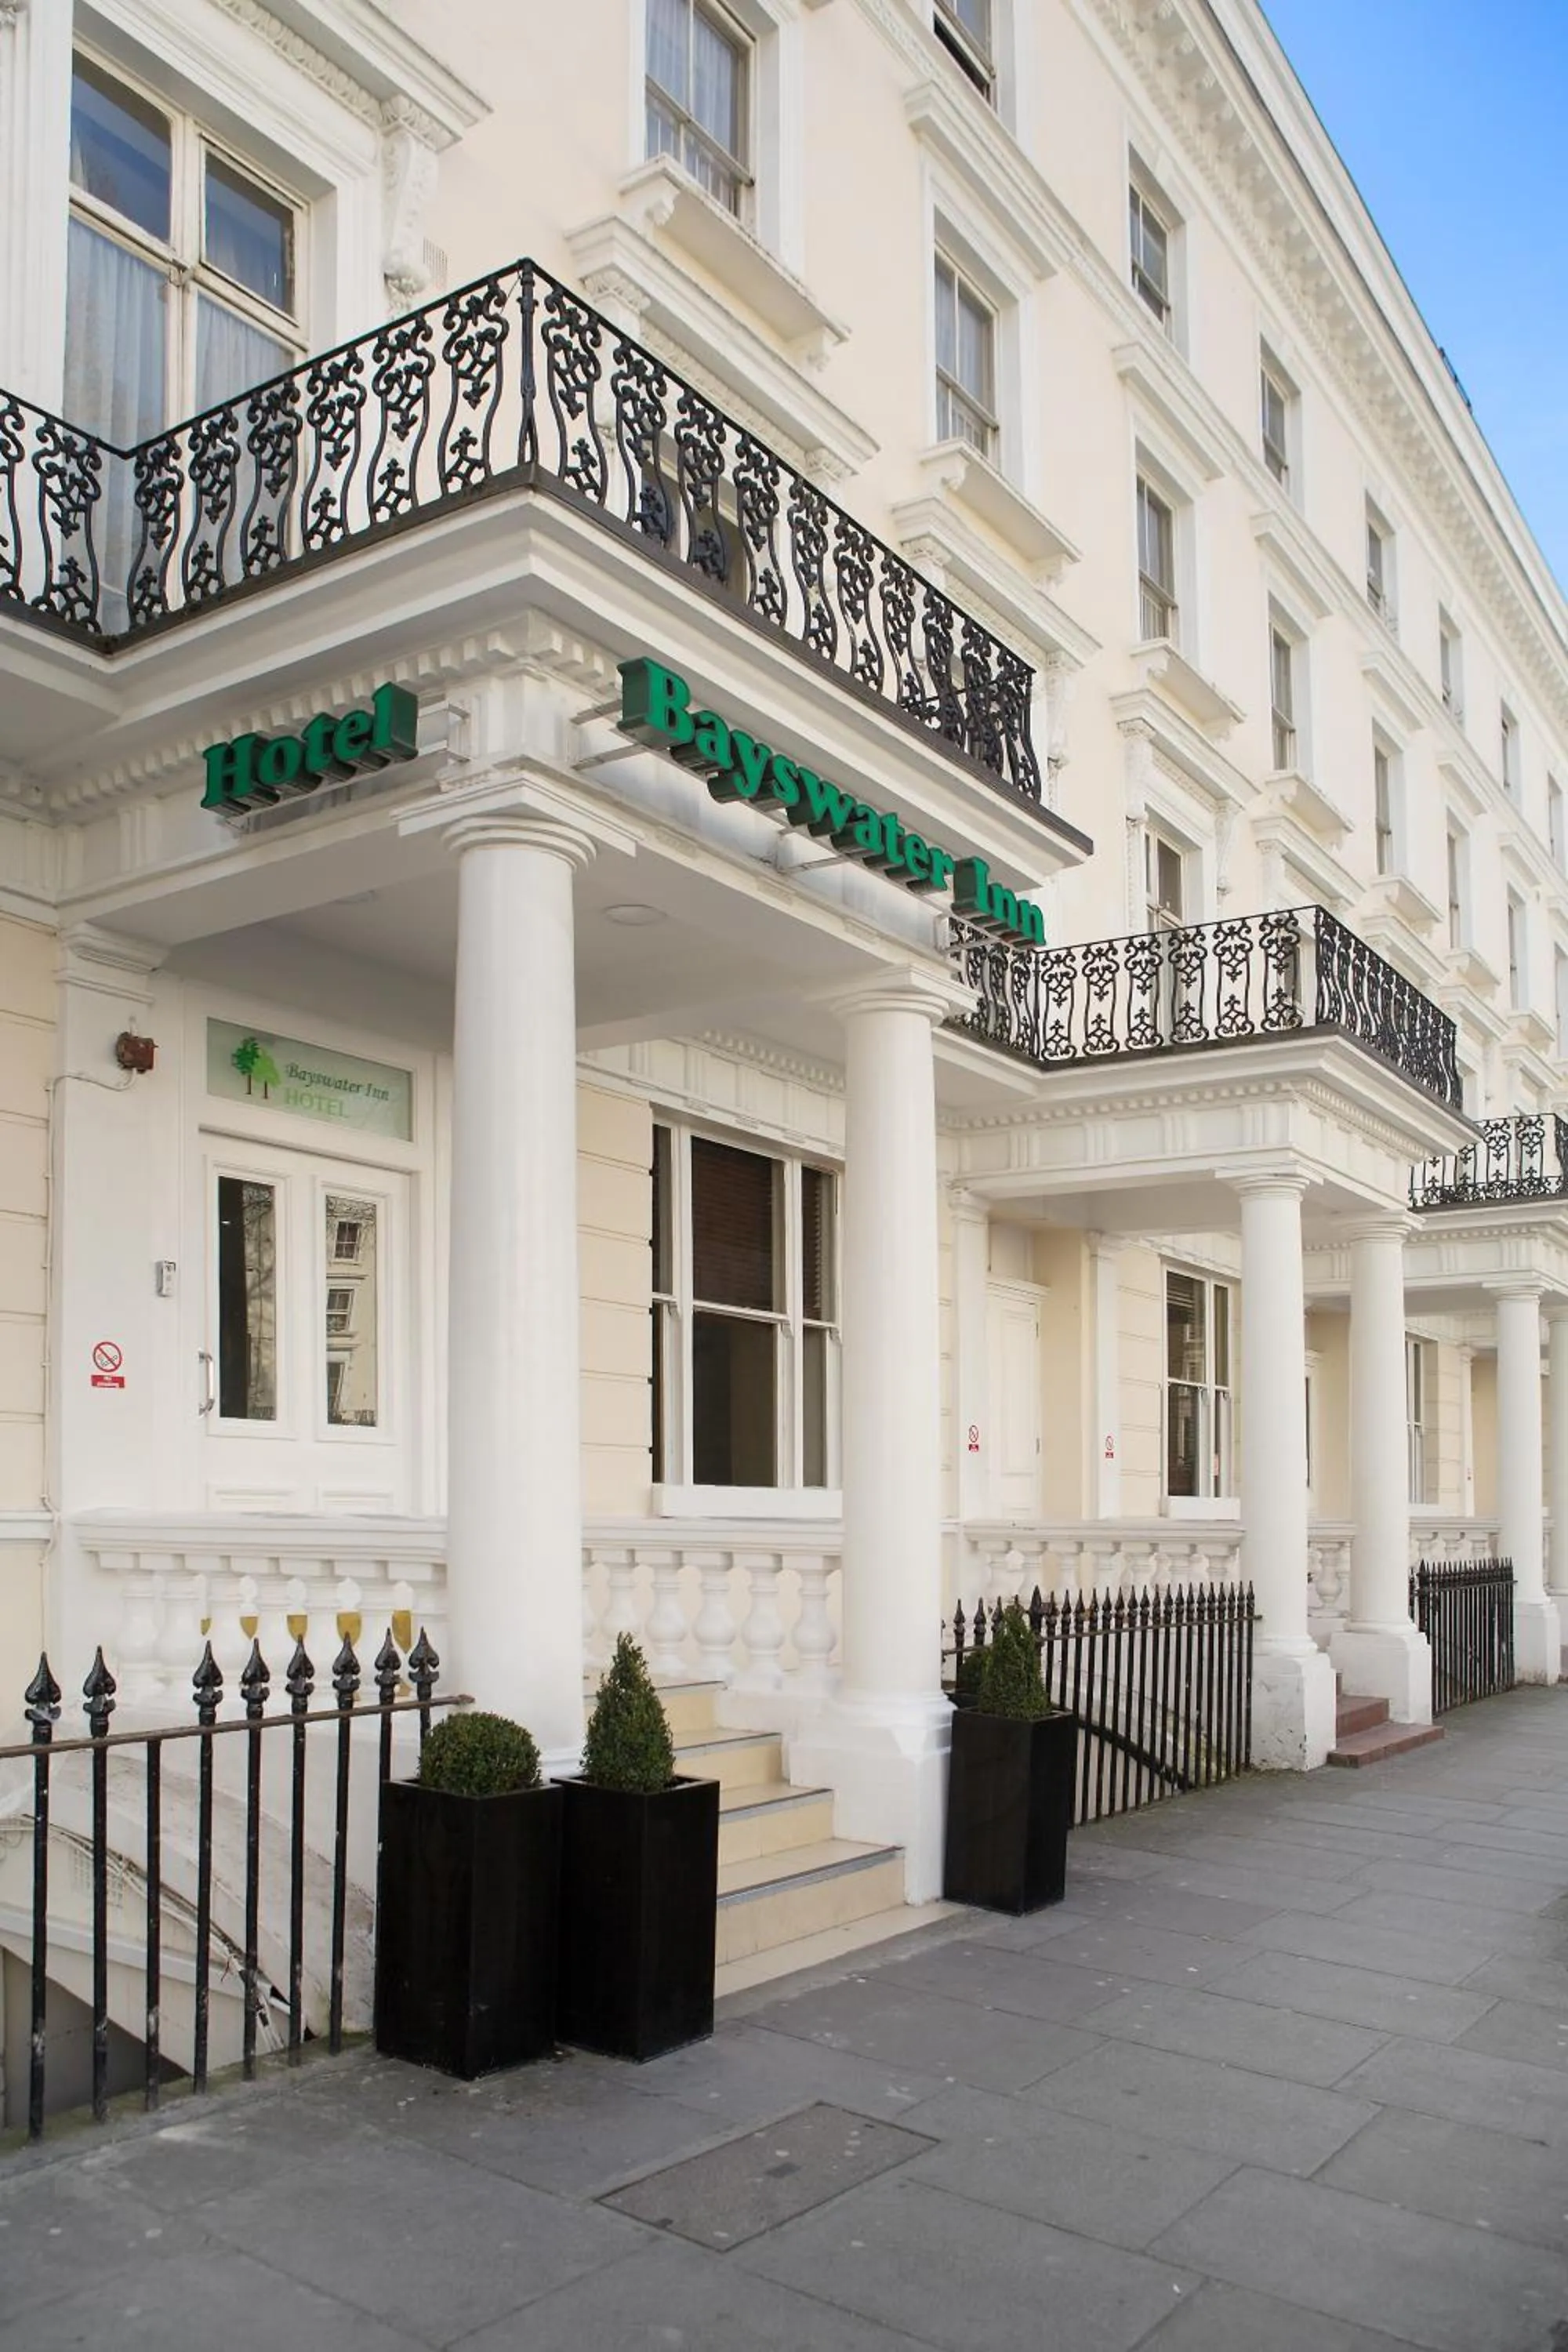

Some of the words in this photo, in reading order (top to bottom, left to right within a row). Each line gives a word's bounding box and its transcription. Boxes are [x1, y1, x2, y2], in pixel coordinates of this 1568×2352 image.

[201, 681, 401, 809] Hotel
[624, 656, 955, 892] Bayswater
[960, 856, 1046, 946] Inn
[285, 1062, 363, 1094] Bayswater
[364, 1083, 390, 1101] Inn
[285, 1087, 350, 1118] HOTEL
